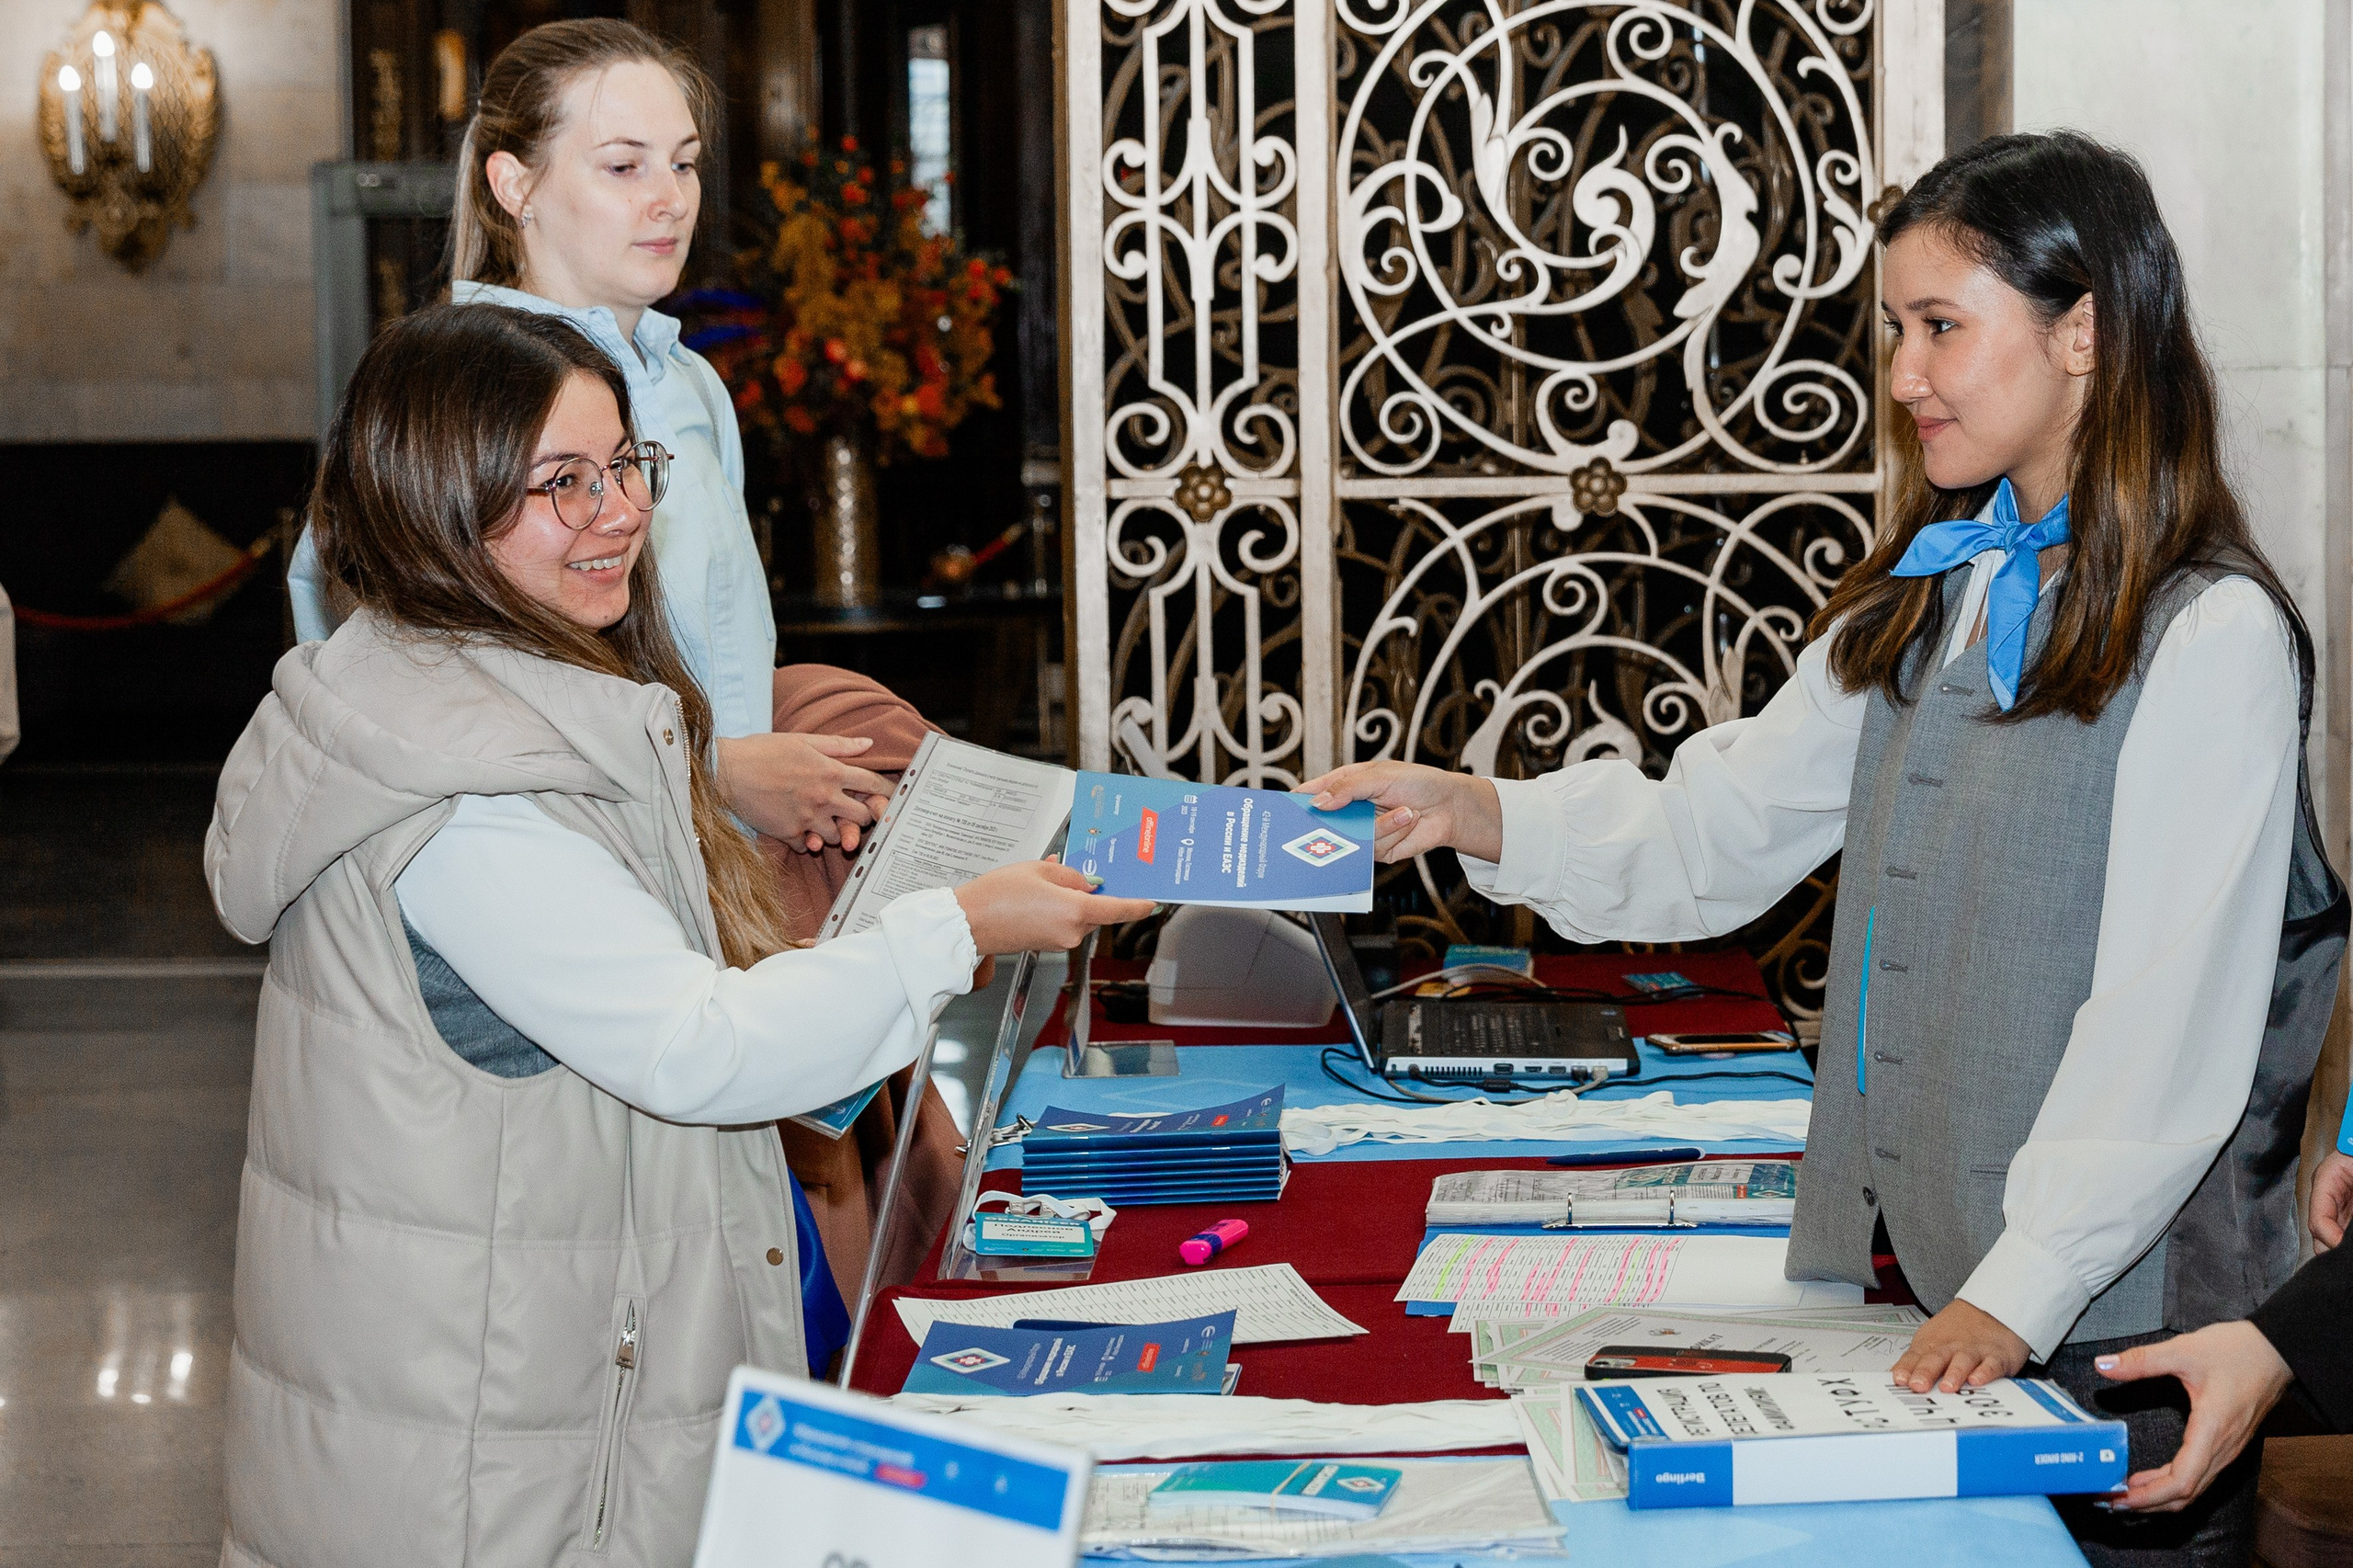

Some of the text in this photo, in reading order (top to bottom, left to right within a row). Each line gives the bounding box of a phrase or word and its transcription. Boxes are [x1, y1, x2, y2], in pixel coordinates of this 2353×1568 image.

[1224, 817, 1235, 846] России
[1236, 798, 1254, 888] Обращение медизделий
[1222, 853, 1233, 873] ЕАЭС
[1655, 1471, 1706, 1484] Berlingo
